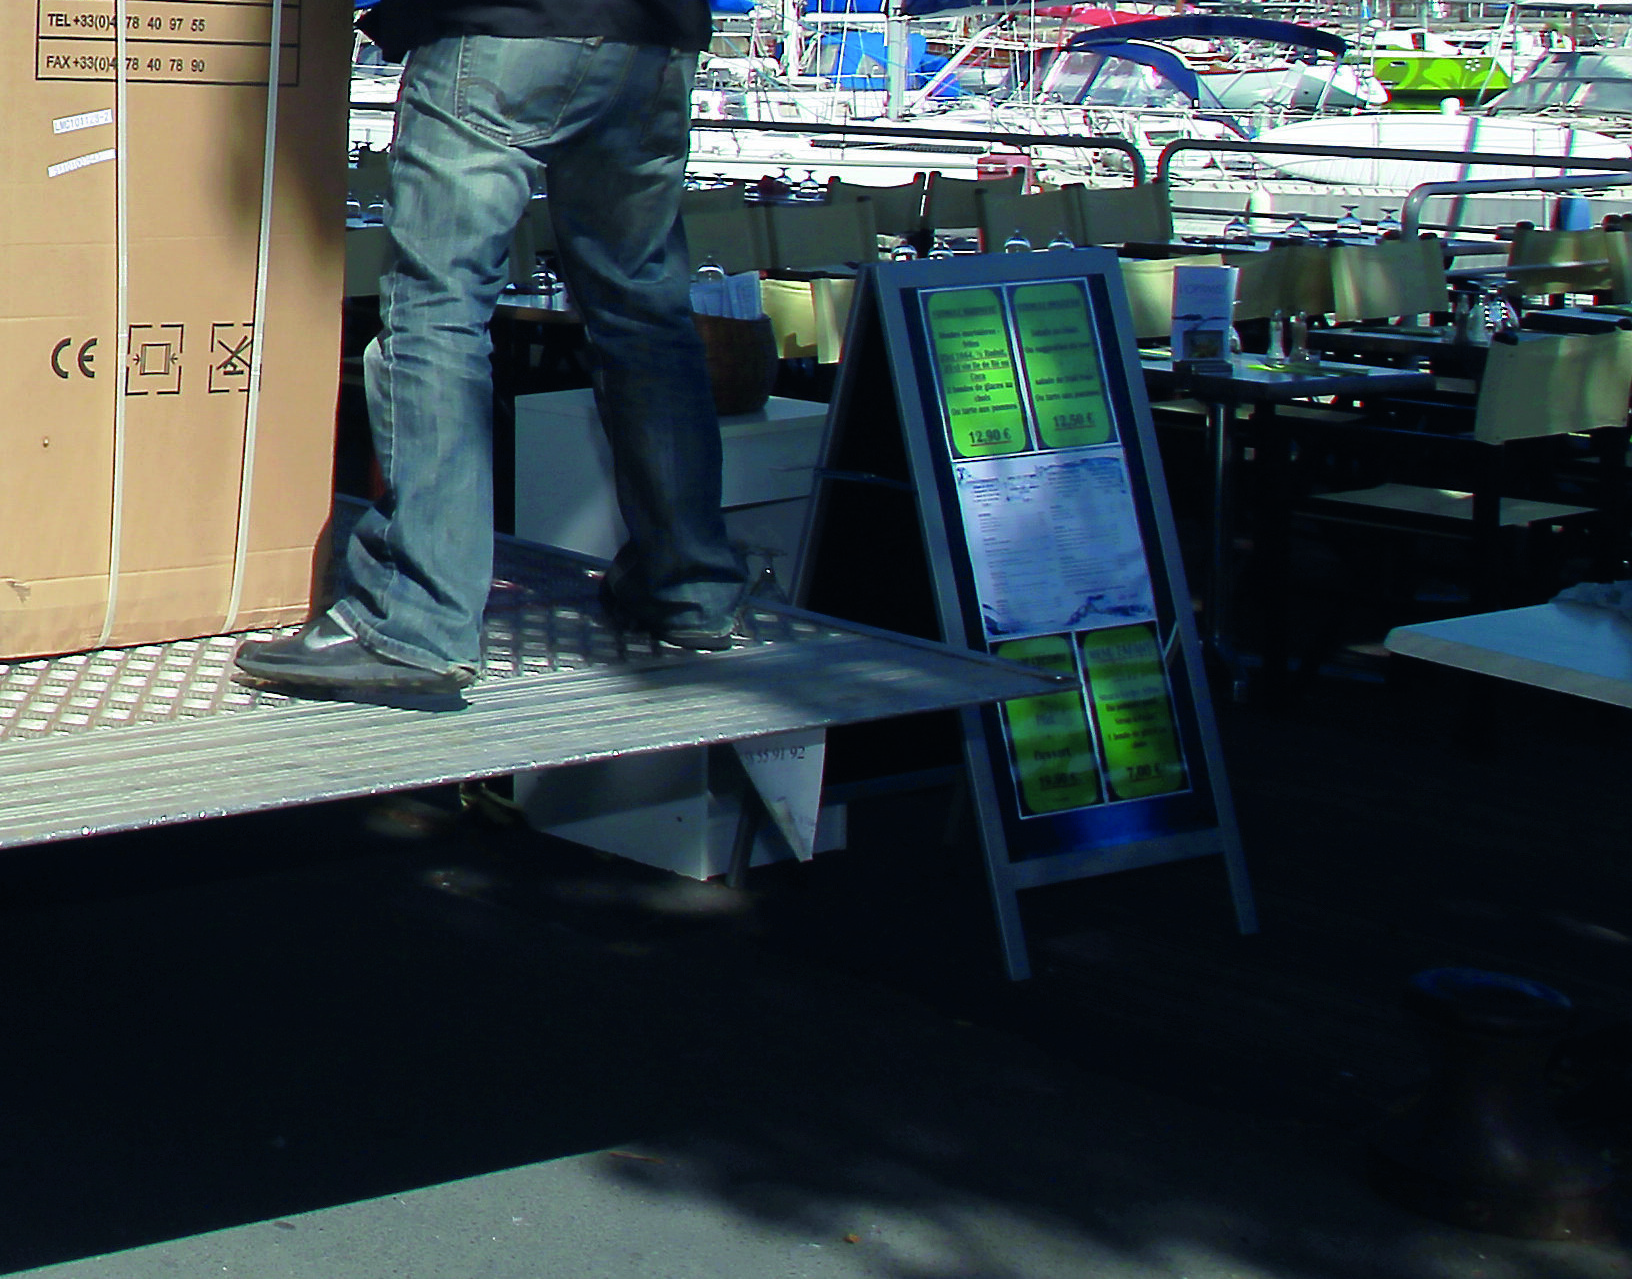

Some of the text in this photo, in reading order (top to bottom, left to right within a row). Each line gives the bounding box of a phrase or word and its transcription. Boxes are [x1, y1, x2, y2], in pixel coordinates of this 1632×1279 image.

[47, 13, 71, 28] TEL
[125, 16, 139, 30] 78
[147, 17, 162, 31] 40
[168, 18, 183, 32] 97
[190, 19, 205, 32] 55
[46, 55, 70, 69] FAX
[125, 57, 139, 71] 78
[147, 58, 161, 71] 40
[169, 59, 183, 72] 78
[191, 59, 205, 72] 90
[772, 747, 785, 761] 91
[789, 745, 805, 759] 92
